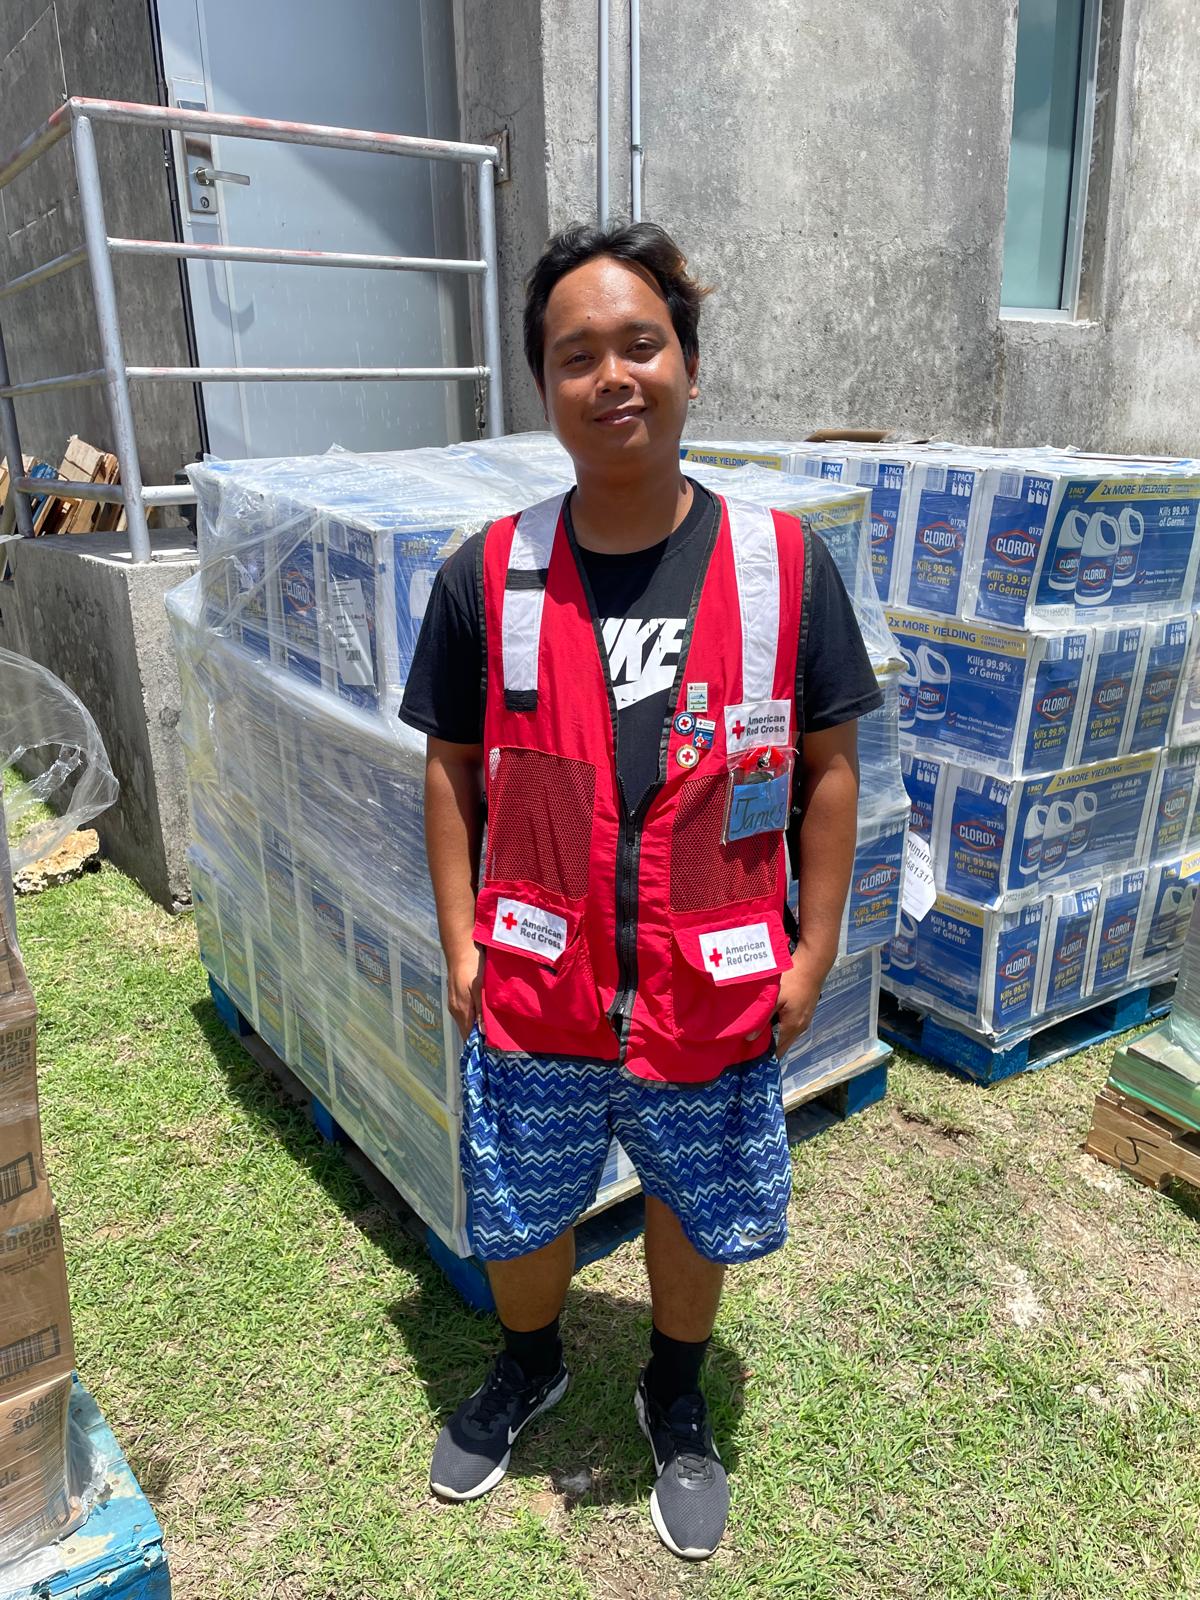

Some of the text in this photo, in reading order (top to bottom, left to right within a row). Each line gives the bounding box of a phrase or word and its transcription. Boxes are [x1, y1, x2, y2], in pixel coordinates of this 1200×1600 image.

[699, 455, 717, 465] MORE
[827, 464, 841, 473] PACK
[889, 467, 903, 476] PACK
[952, 472, 973, 483] 3 PACK
[1029, 480, 1050, 490] 3 PACK
[1101, 486, 1112, 496] 2x
[1112, 485, 1134, 495] MORE
[1138, 484, 1171, 494] YIELDING
[1159, 506, 1190, 516] Kills 99.9%
[1166, 517, 1185, 527] Germs
[924, 529, 957, 548] CLOROX
[996, 538, 1036, 558] CLOROX
[872, 554, 888, 565] 9.9%
[916, 560, 956, 577] Kills 99.9%
[986, 570, 1004, 582] Kills
[1082, 568, 1106, 580] CLOROX
[918, 572, 950, 586] of Germs
[988, 582, 1028, 598] of Germs
[888, 616, 976, 643] 2x MORE YIELDING
[598, 617, 688, 682] IKE
[1073, 637, 1084, 646] PACK
[967, 655, 1012, 672] Kills 99.9%
[969, 666, 1006, 682] of Germs
[1098, 686, 1124, 704] CLOROX
[1042, 696, 1070, 713] CLOROX
[748, 714, 786, 726] American
[1090, 718, 1102, 730] Kills
[746, 725, 785, 736] Red Cross
[1034, 727, 1066, 740] Kills 99.9%
[1034, 738, 1062, 750] of Germs
[922, 762, 938, 773] PACK
[1056, 764, 1122, 787] 2x MORE YIELDING
[730, 796, 785, 834] James
[959, 825, 996, 846] CLOROX
[954, 851, 970, 864] Kills
[956, 862, 995, 879] of Germs
[860, 870, 892, 892] CLOROX
[854, 906, 869, 918] Kills
[866, 909, 889, 922] Germs
[522, 918, 562, 940] American
[930, 914, 972, 938] Kills 99.9%
[1108, 922, 1131, 940] CLOROX
[520, 927, 561, 950] Red Cross
[932, 926, 966, 945] of Germs
[725, 940, 766, 956] American
[1060, 939, 1084, 957] CLOROX
[726, 950, 768, 966] Red Cross
[1005, 956, 1032, 976] CLOROX
[1000, 990, 1013, 1001] Kills
[1008, 993, 1027, 1005] Germs
[406, 991, 436, 1026] CLOROX
